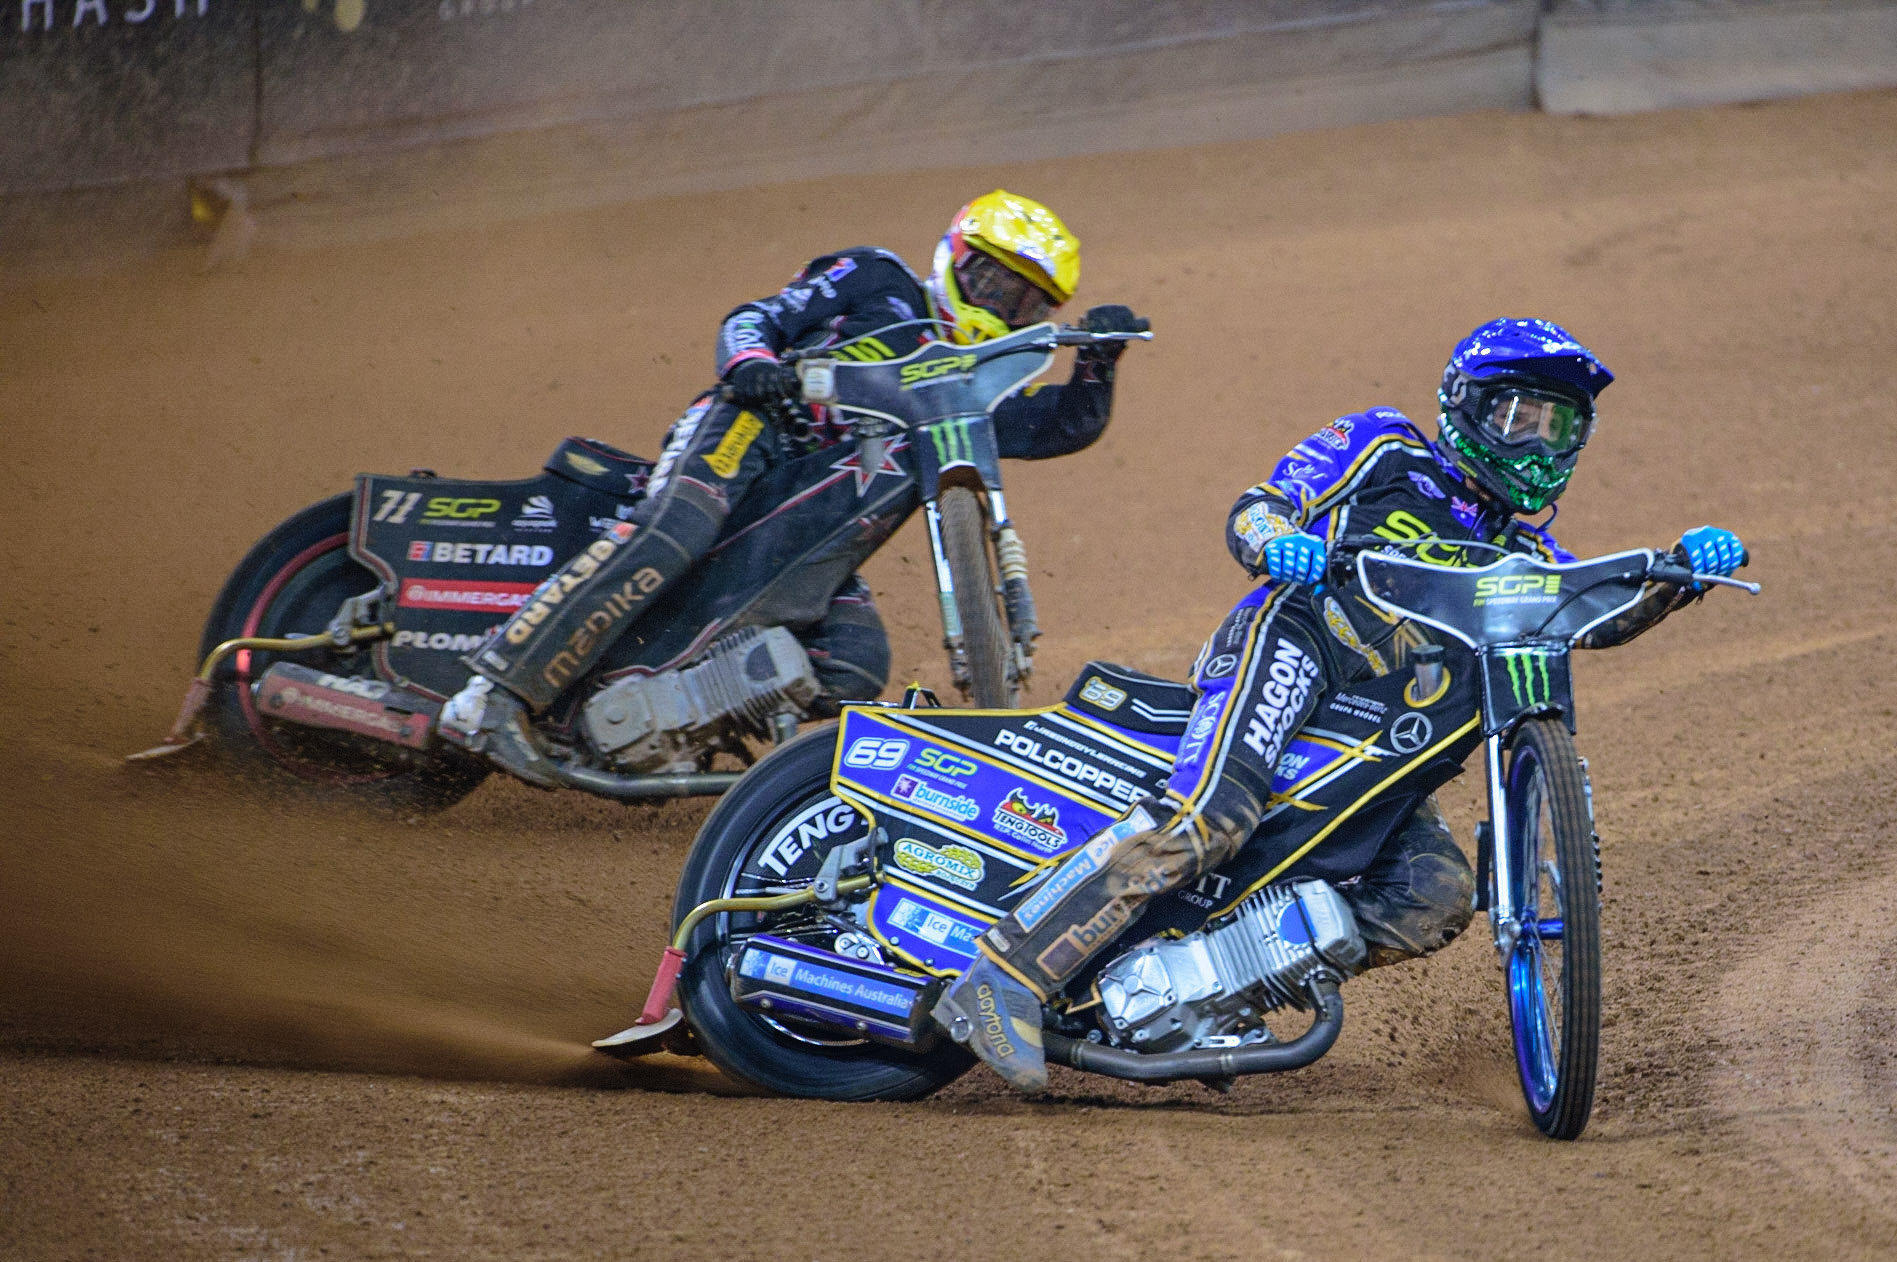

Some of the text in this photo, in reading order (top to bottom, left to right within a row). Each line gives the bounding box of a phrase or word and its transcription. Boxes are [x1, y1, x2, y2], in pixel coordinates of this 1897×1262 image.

[900, 355, 962, 384] SGP
[373, 490, 423, 524] 71
[423, 498, 501, 518] SGP
[432, 541, 554, 567] BETARD
[1475, 574, 1546, 597] SGP
[1080, 678, 1126, 710] 69
[1242, 638, 1304, 756] HAGON
[1264, 654, 1319, 769] SHOCKS
[844, 737, 910, 771] 69
[914, 747, 978, 777] SGP
[915, 781, 979, 819] burnside
[758, 796, 855, 877] TENG
[995, 809, 1063, 848] TENGTOOLS
[903, 843, 978, 879] AGROMIX
[1094, 837, 1115, 858] Ice
[1024, 858, 1092, 920] Machines
[1177, 888, 1214, 911] GROUP
[927, 915, 948, 934] Ice
[770, 961, 910, 1010] Ice Machines Australia
[976, 983, 1015, 1058] daytona
